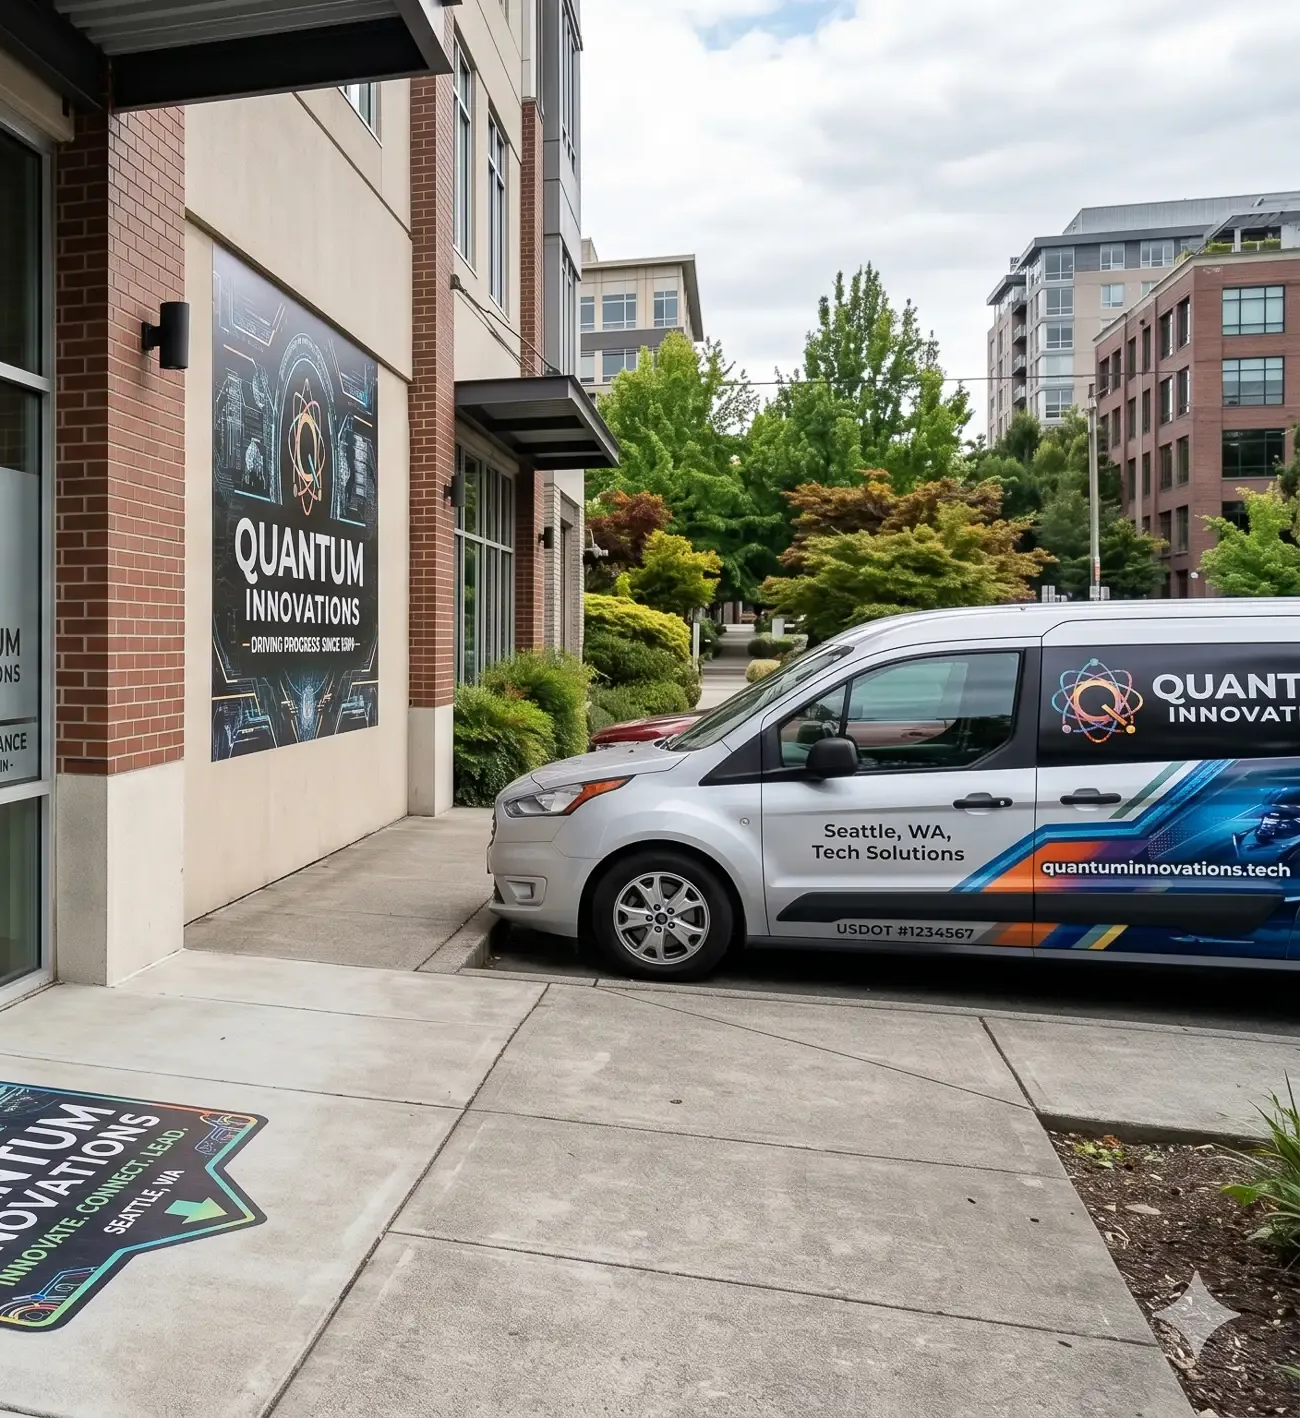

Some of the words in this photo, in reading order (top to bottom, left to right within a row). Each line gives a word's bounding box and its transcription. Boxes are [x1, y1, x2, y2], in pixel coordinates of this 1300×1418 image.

[235, 517, 364, 587] QUANTUM
[246, 589, 360, 626] INNOVATIONS
[251, 636, 282, 653] DRIVING
[1169, 706, 1300, 722] INNOVAT
[0, 759, 9, 772] IN
[824, 823, 902, 841] Seattle,
[908, 824, 952, 842] WA,
[812, 844, 860, 860] Tech
[866, 845, 965, 861] Solutions
[1042, 860, 1291, 877] quantuminnovations.tech
[836, 923, 893, 936] USDOT
[897, 926, 975, 940] #1234567
[76, 1158, 155, 1214] CONNECT.
[147, 1126, 190, 1158] LEAD.
[103, 1188, 172, 1235] SEATTLE,
